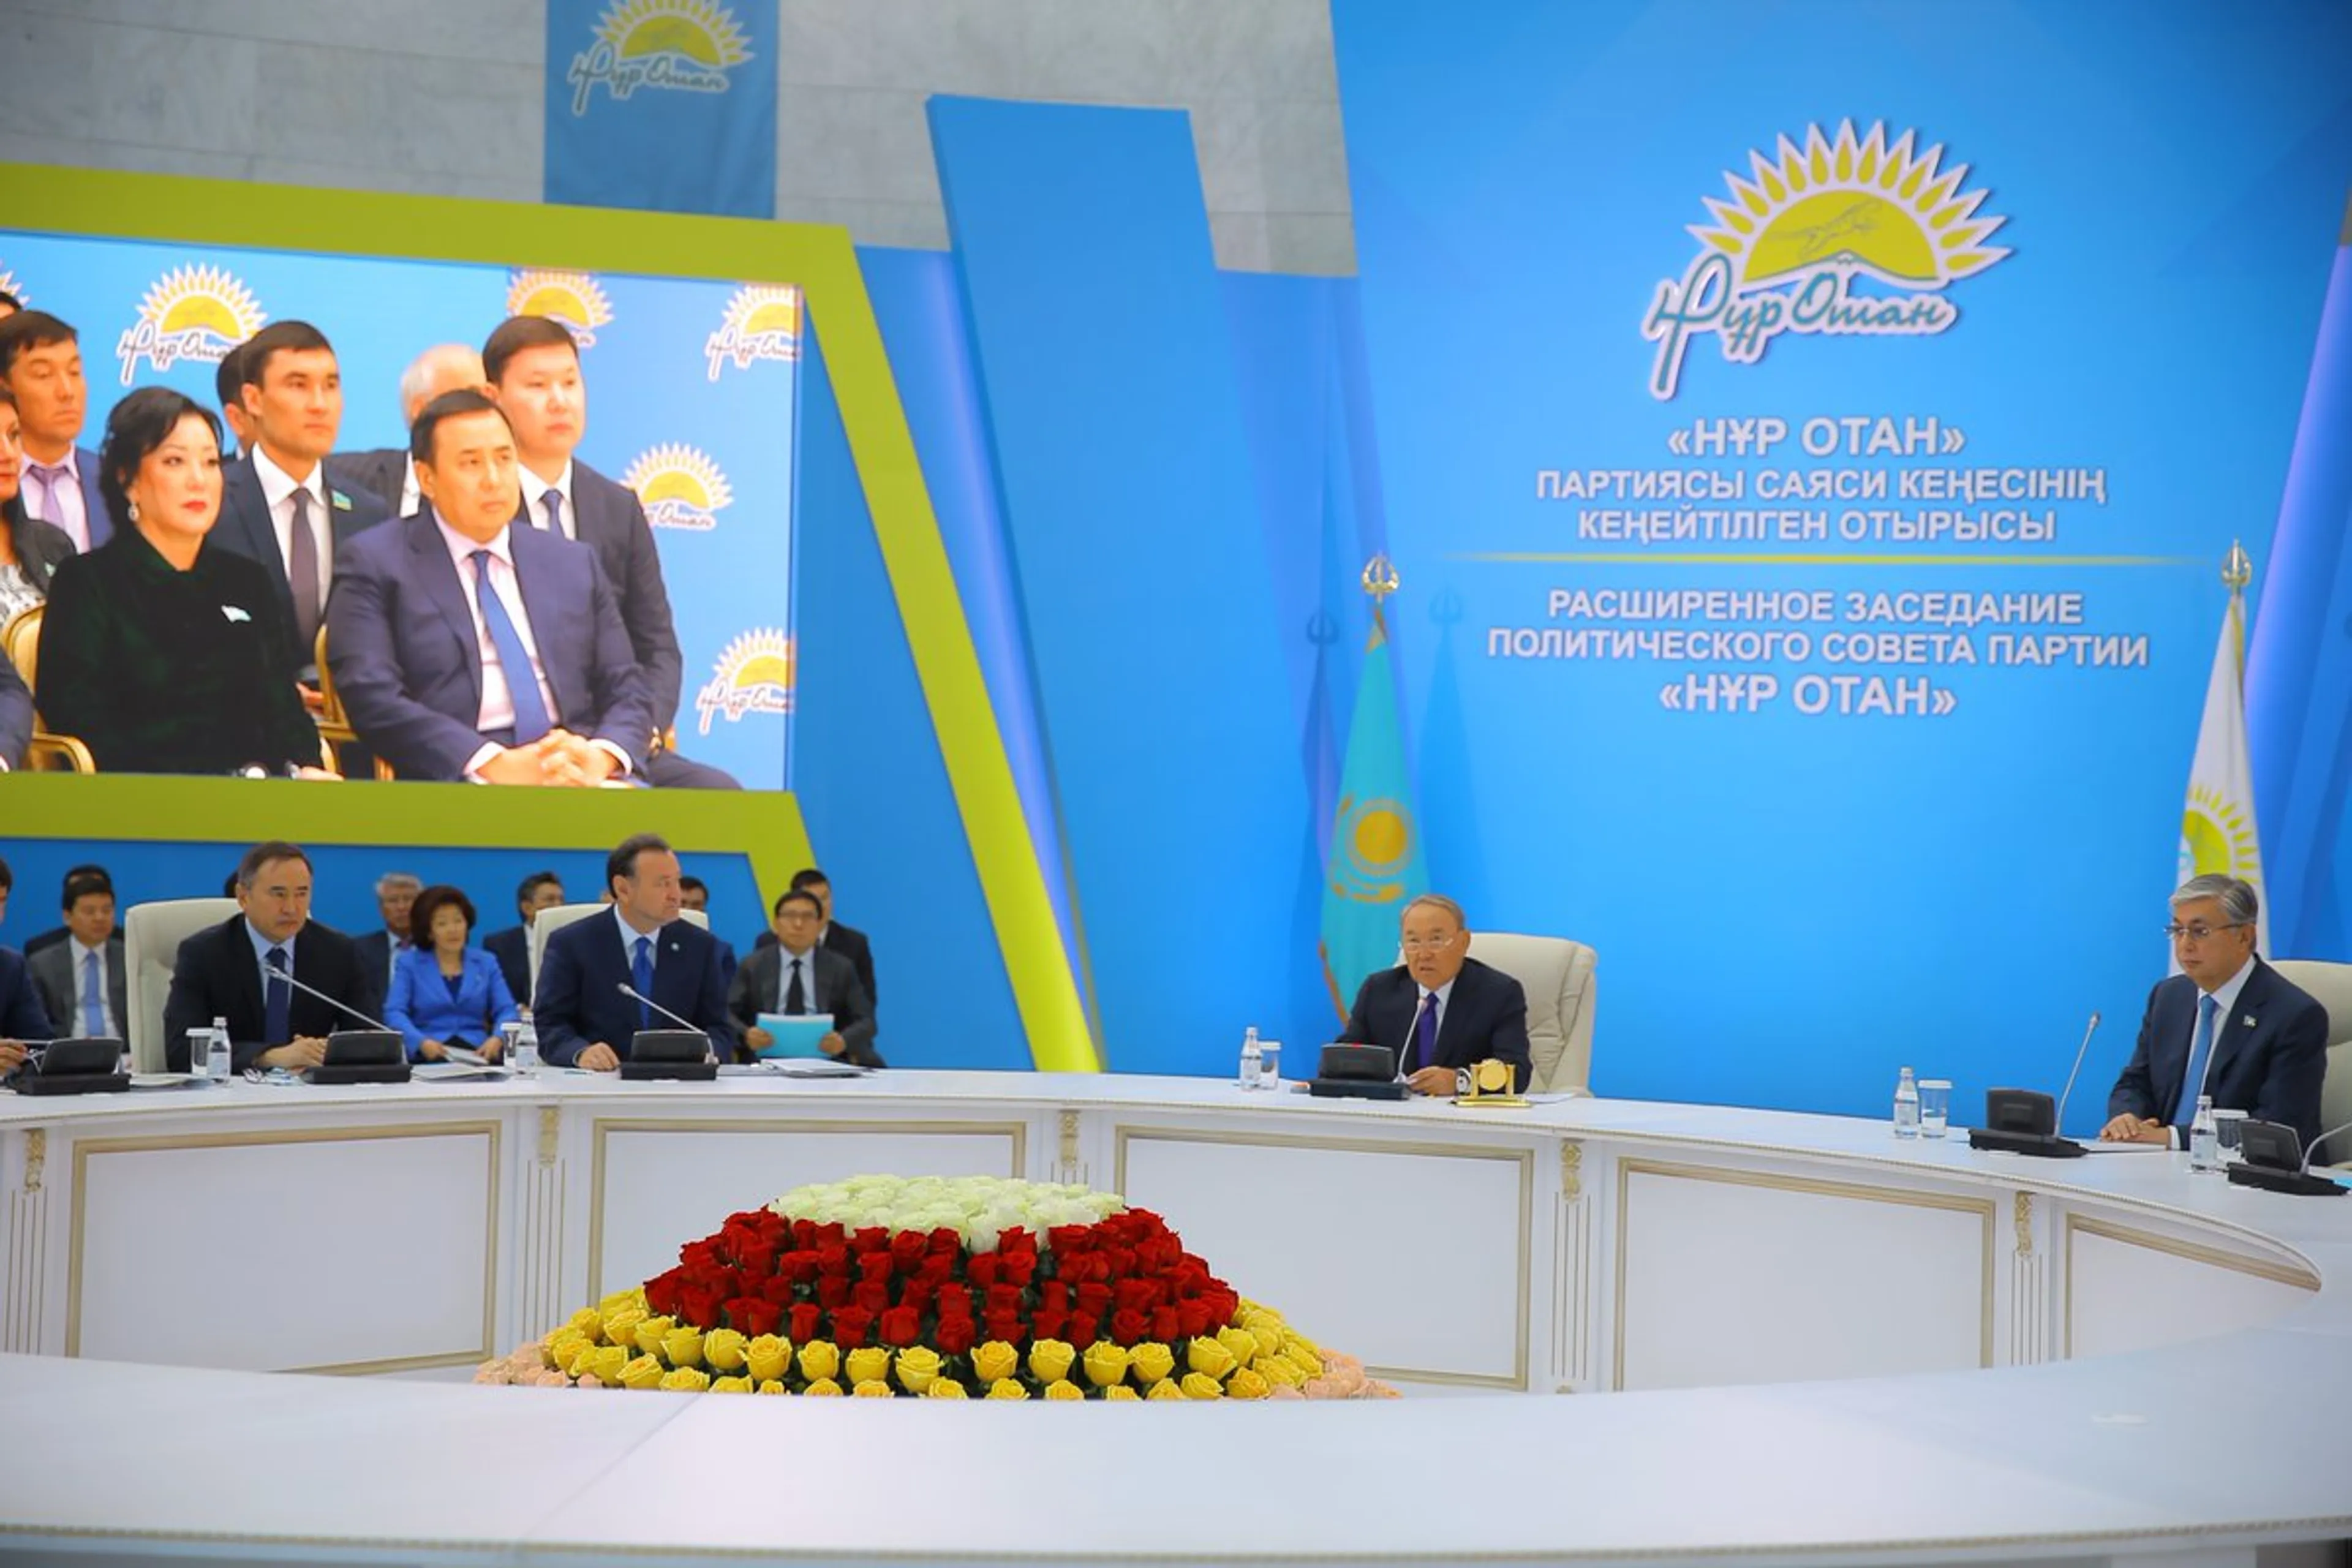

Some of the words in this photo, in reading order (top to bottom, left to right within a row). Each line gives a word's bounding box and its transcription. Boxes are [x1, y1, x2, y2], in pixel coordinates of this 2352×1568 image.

[1787, 271, 1951, 330] Отан
[181, 331, 228, 360] Ота
[1668, 418, 1787, 456] «НҰР
[1802, 417, 1964, 456] ОТАН»
[1537, 470, 1744, 499] ПАРТИЯСЫ
[1755, 469, 1886, 499] САЯСИ
[1899, 469, 2105, 503] КЕҢЕСІНІҢ
[1578, 504, 1827, 545] КЕҢЕЙТІЛГЕН
[1839, 510, 2054, 540] ОТЫРЫСЫ
[1549, 589, 1833, 620] РАСШИРЕННОЕ
[1845, 592, 2081, 627] ЗАСЕДАНИЕ
[1489, 628, 1811, 661] ПОЛИТИЧЕСКОГО
[1822, 632, 1975, 663] СОВЕТА
[1989, 635, 2146, 665] ПАРТИИ
[1660, 674, 1777, 712] «НҰР
[1793, 675, 1956, 715] ОТАН»
